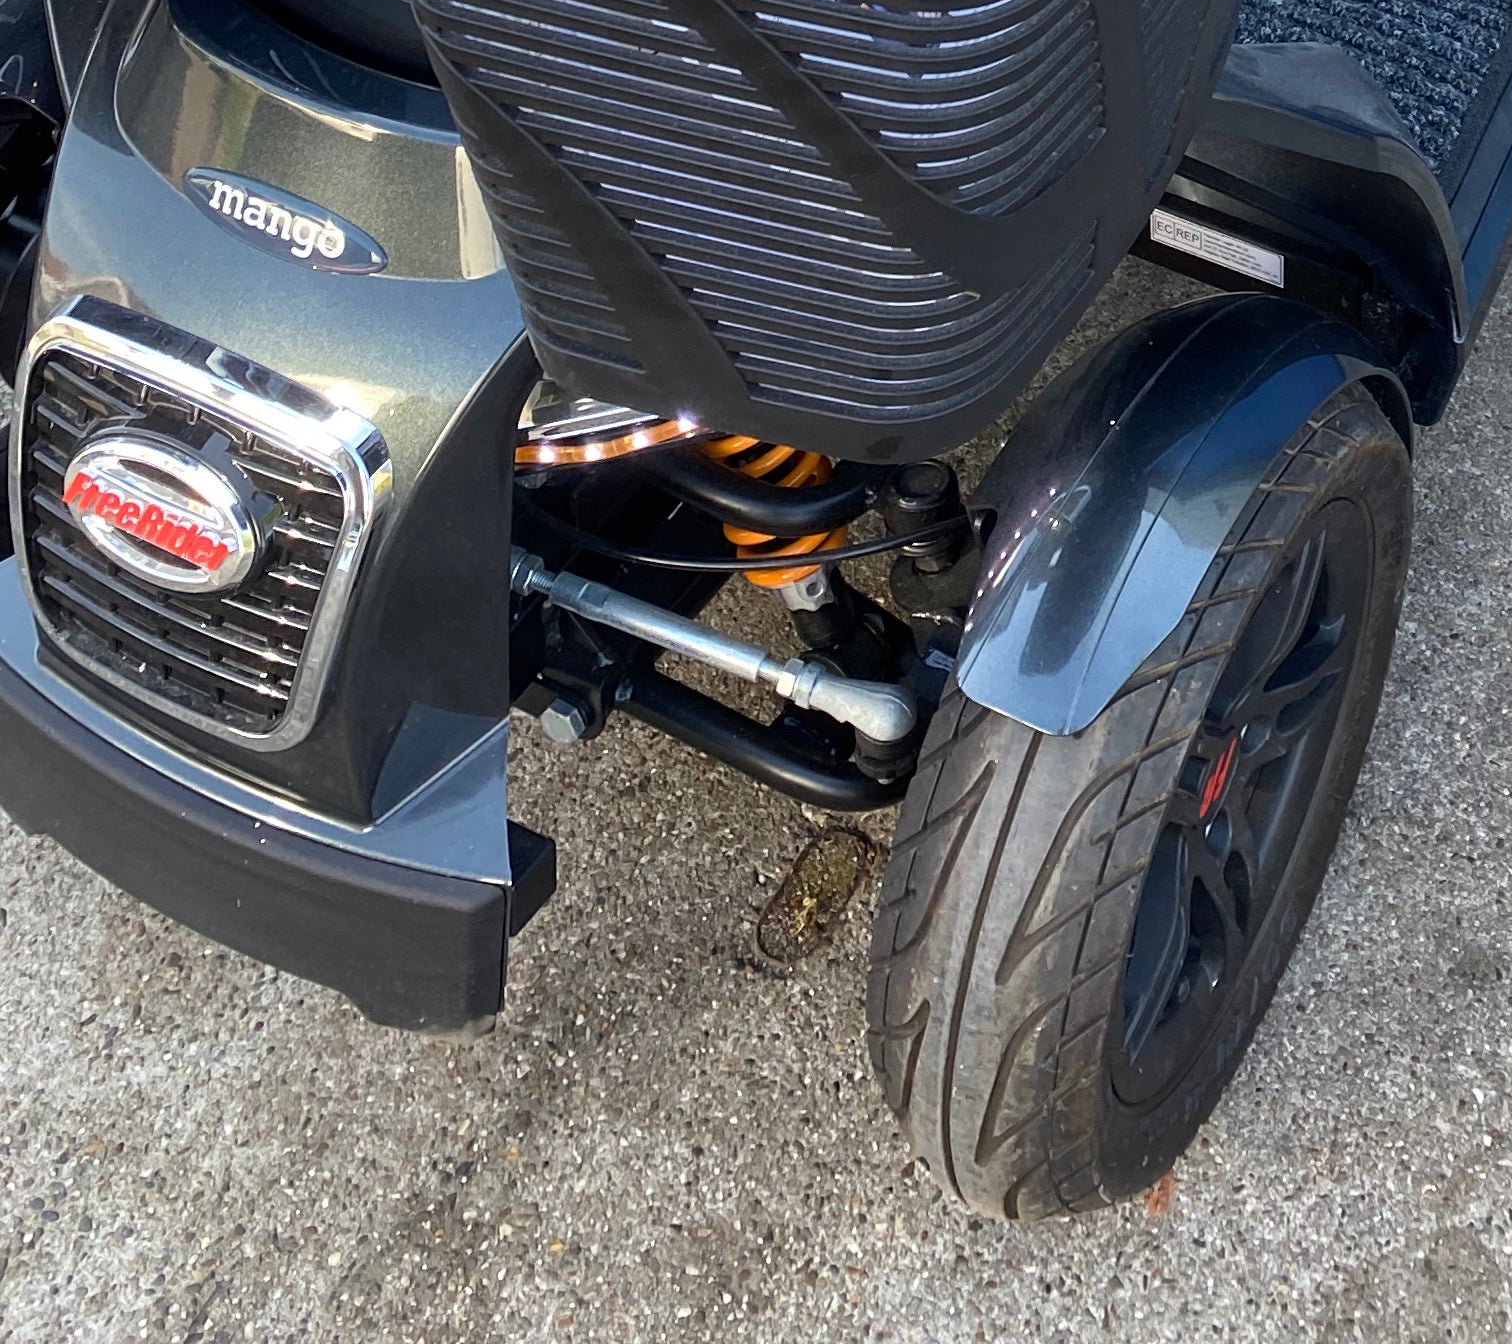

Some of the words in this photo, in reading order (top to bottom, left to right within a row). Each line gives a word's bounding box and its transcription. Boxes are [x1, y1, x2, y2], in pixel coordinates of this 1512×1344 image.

[208, 179, 346, 259] mango
[1157, 221, 1173, 234] EC
[1176, 228, 1200, 243] REP
[62, 472, 229, 570] FreeRider
